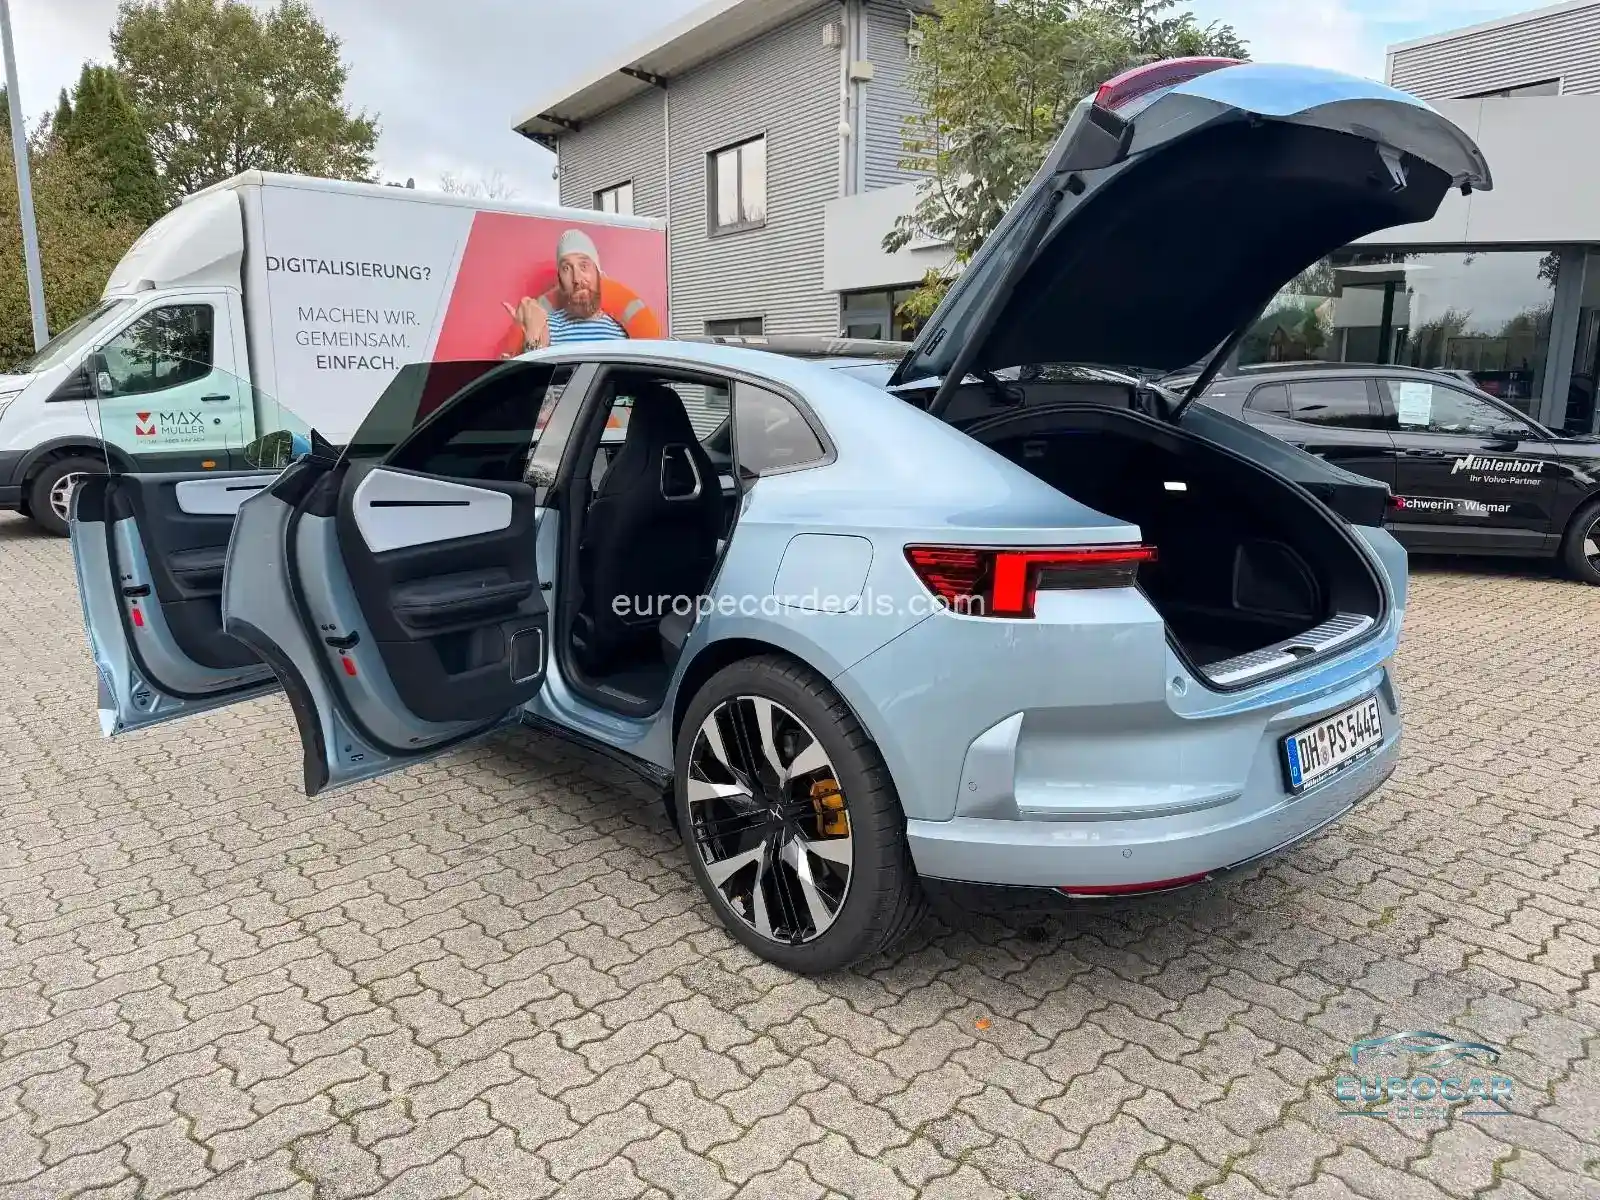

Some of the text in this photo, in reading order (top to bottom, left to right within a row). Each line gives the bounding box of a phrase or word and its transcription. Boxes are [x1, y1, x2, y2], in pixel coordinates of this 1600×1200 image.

[266, 256, 432, 280] DIGITALISIERUNG?
[298, 306, 421, 326] MACHEN WIR.
[296, 330, 410, 348] GEMEINSAM.
[316, 355, 400, 370] EINFACH.
[159, 411, 204, 425] MAX
[1450, 454, 1544, 475] Mühlenhort
[1469, 474, 1542, 486] Ihr Volvo-Partner
[1464, 501, 1511, 513] Wismar
[1298, 732, 1321, 774] DH
[1326, 719, 1347, 759] PS
[1346, 702, 1379, 748] 544E
